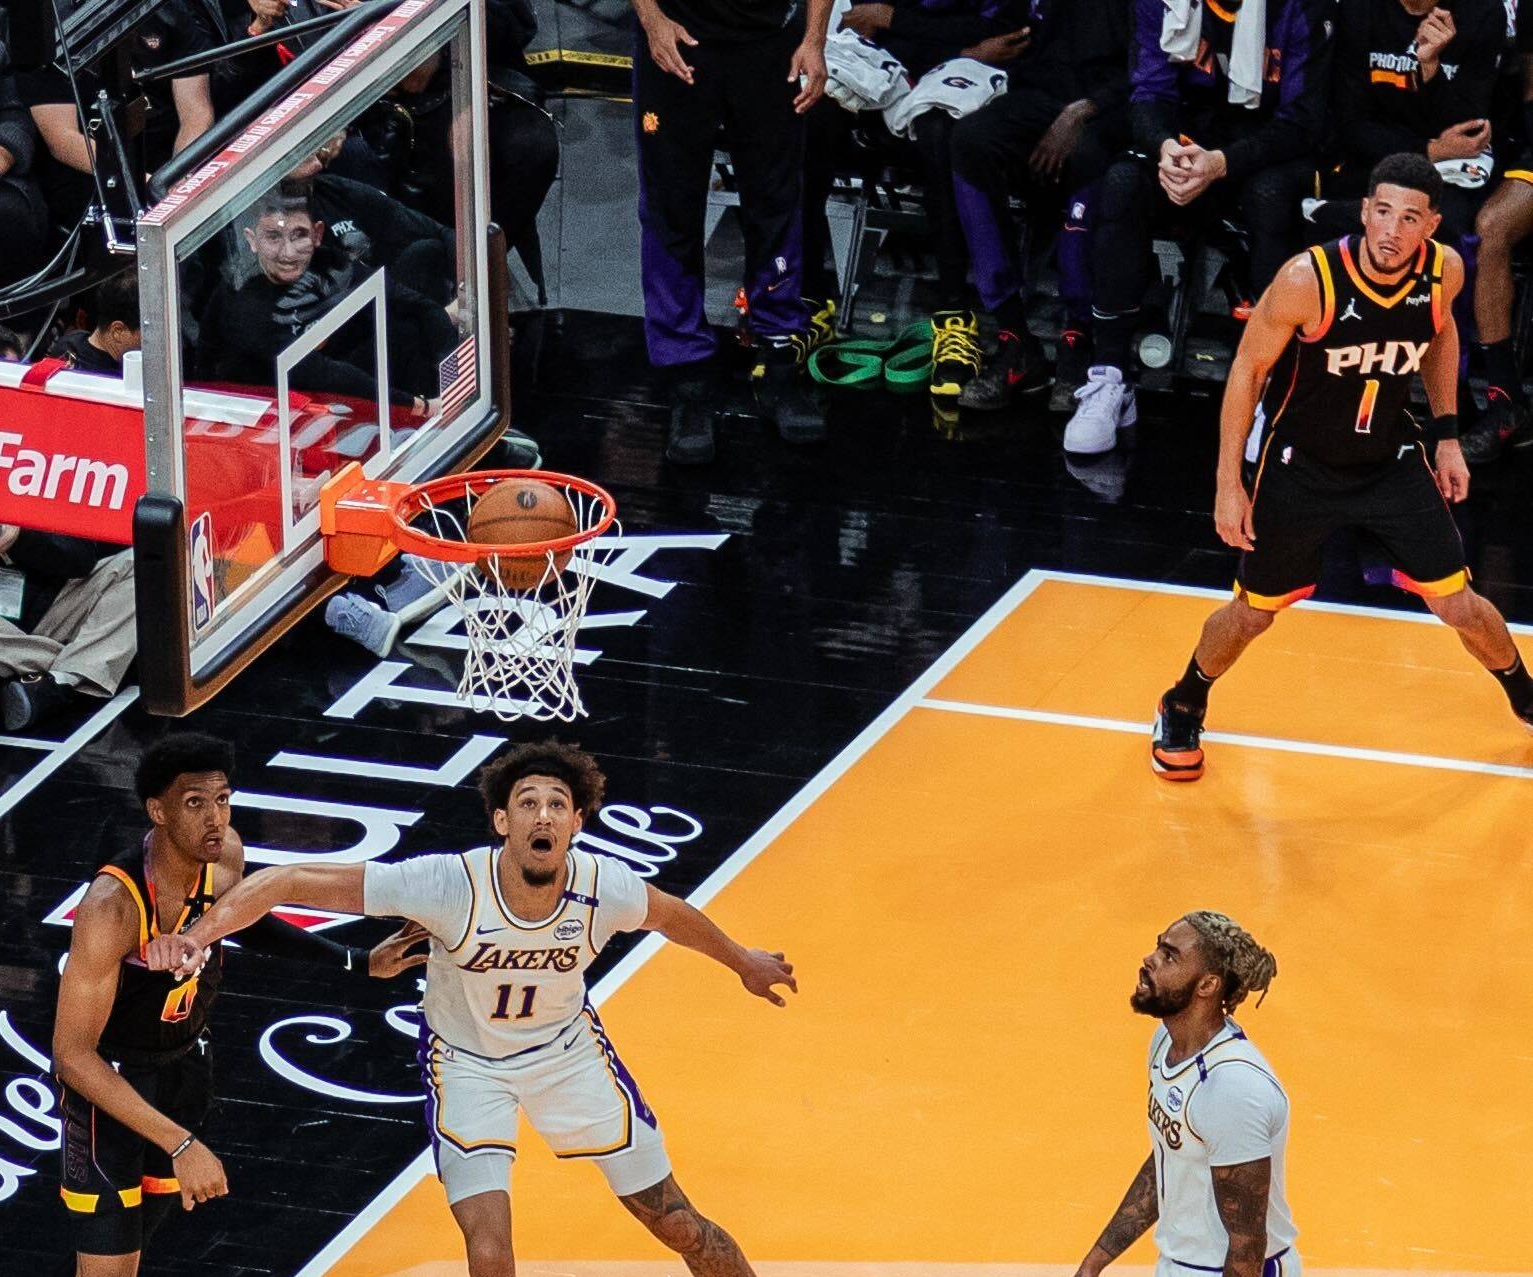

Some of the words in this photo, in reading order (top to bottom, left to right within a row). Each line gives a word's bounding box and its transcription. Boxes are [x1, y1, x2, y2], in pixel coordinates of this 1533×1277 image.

[330, 219, 358, 238] PHX
[1324, 341, 1430, 377] PHX
[1355, 379, 1380, 434] 1
[456, 942, 581, 974] LAKERS
[489, 984, 539, 1021] 11
